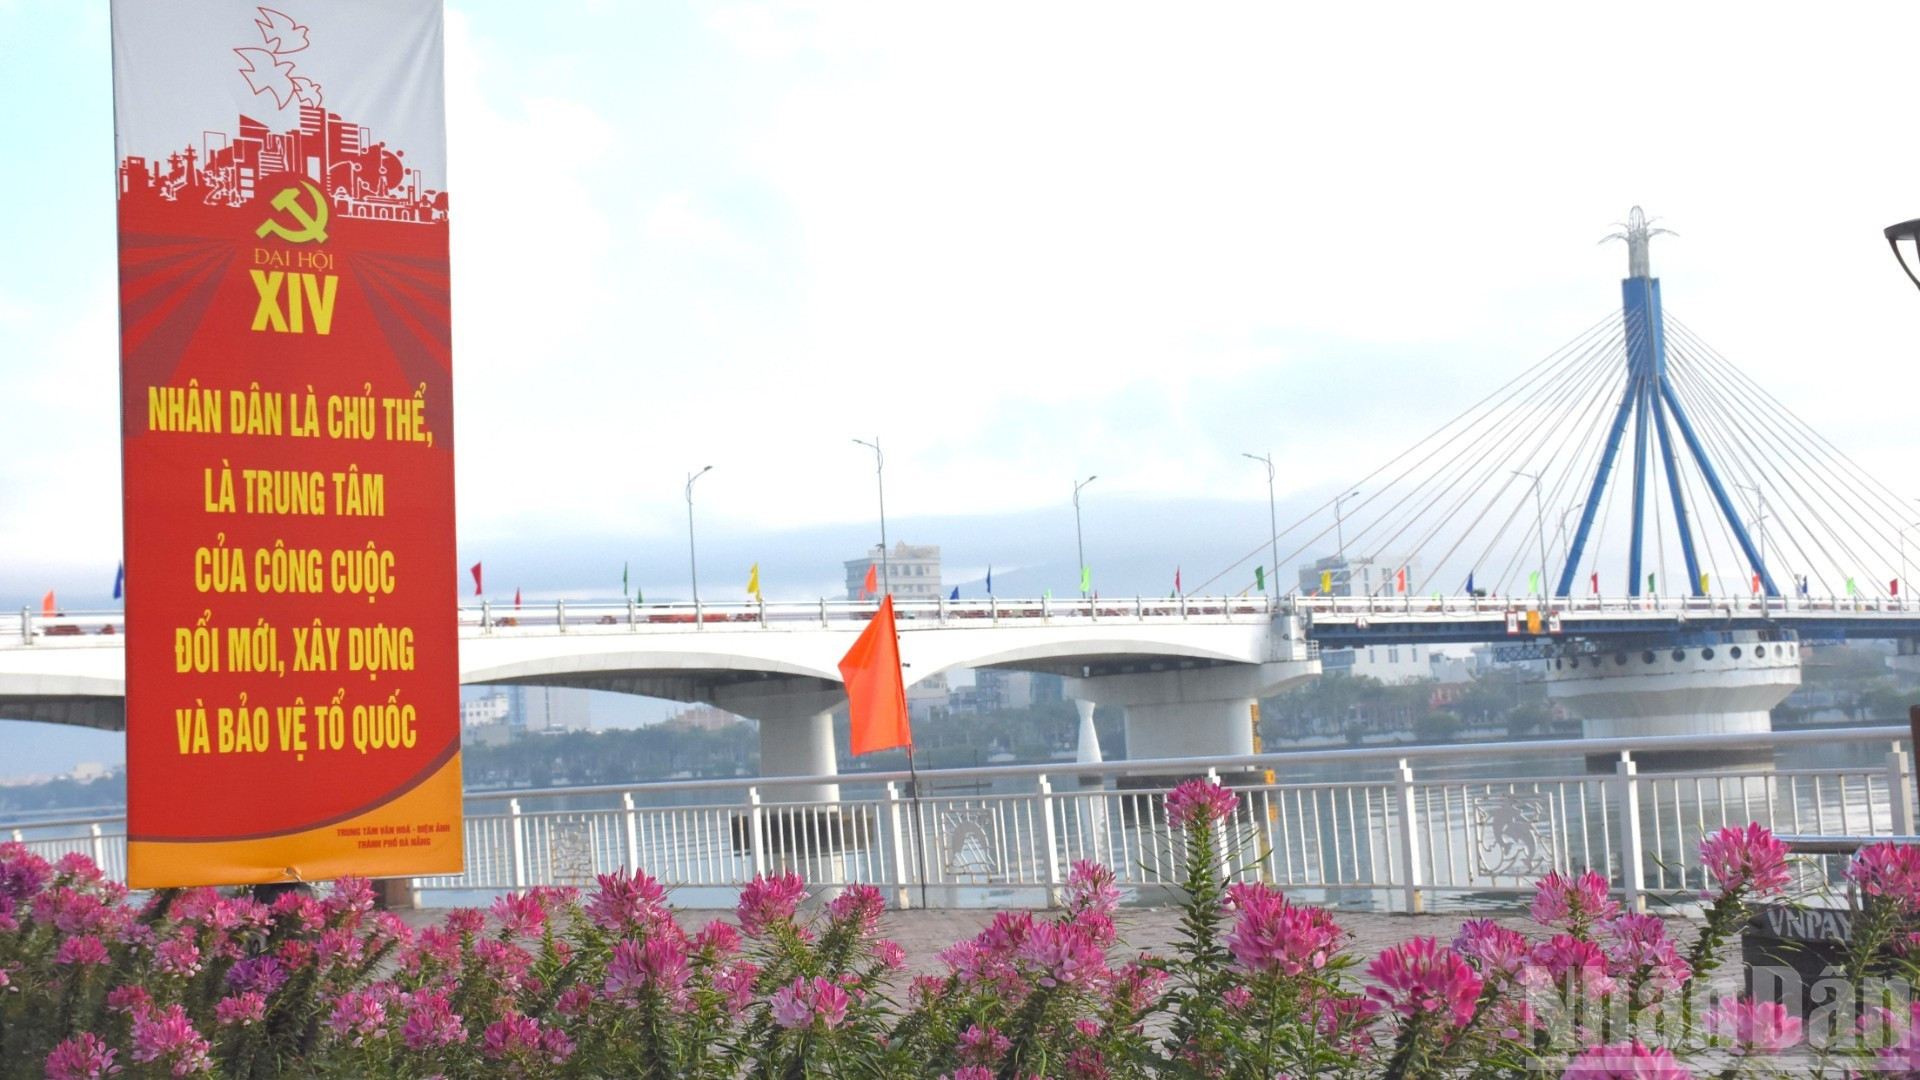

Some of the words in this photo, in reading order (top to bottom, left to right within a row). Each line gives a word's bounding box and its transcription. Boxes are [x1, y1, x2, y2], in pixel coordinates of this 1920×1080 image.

[254, 248, 290, 268] ĐẠI
[298, 250, 334, 271] HỘI
[249, 269, 339, 335] XIV
[148, 378, 222, 433] NHÂN
[230, 381, 282, 436] DÂN
[290, 385, 320, 437] LÀ
[328, 382, 375, 440] CHỦ
[383, 382, 433, 448] THỂ,
[205, 459, 236, 513] LÀ
[243, 469, 325, 515] TRUNG
[332, 464, 385, 517] TÂM
[195, 533, 247, 593] CỦA
[255, 539, 323, 593] CÔNG
[331, 541, 395, 603] CUỘC
[175, 609, 219, 673] ĐỔI
[228, 618, 285, 677] MỚI,
[293, 618, 340, 671] XÂY
[348, 623, 414, 681] DỰNG
[176, 699, 210, 754] VÀ
[218, 692, 269, 753] BẢO
[277, 697, 307, 761] VỆ
[315, 688, 345, 750] TỔ
[353, 689, 417, 754] QUỐC
[337, 828, 361, 836] TRUNG
[362, 826, 378, 836] TÂM
